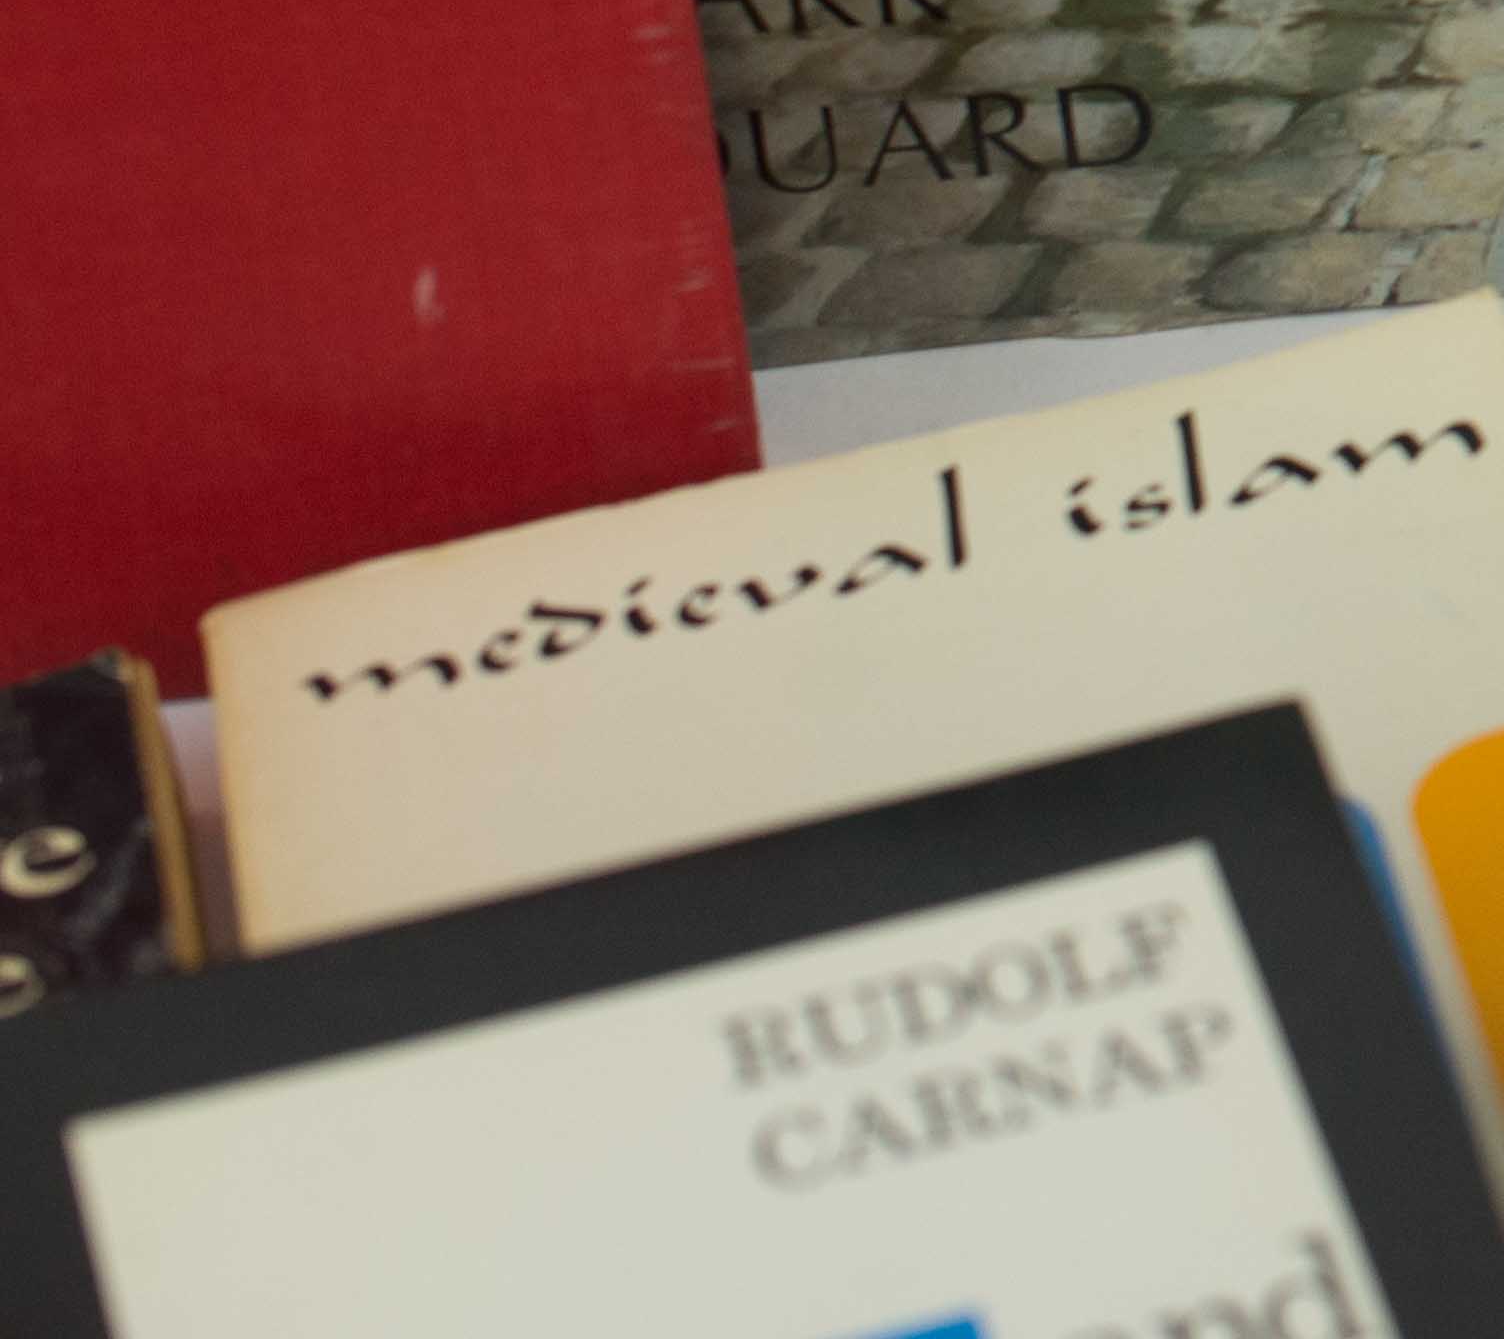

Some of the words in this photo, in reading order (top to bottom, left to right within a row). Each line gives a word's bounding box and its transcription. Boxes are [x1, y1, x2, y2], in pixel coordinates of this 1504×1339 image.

[718, 82, 1154, 194] UARD
[299, 466, 974, 709] medieval
[1064, 410, 1488, 541] islam
[719, 900, 1188, 1091] RUDOLF
[748, 1001, 1236, 1195] CARNAP
